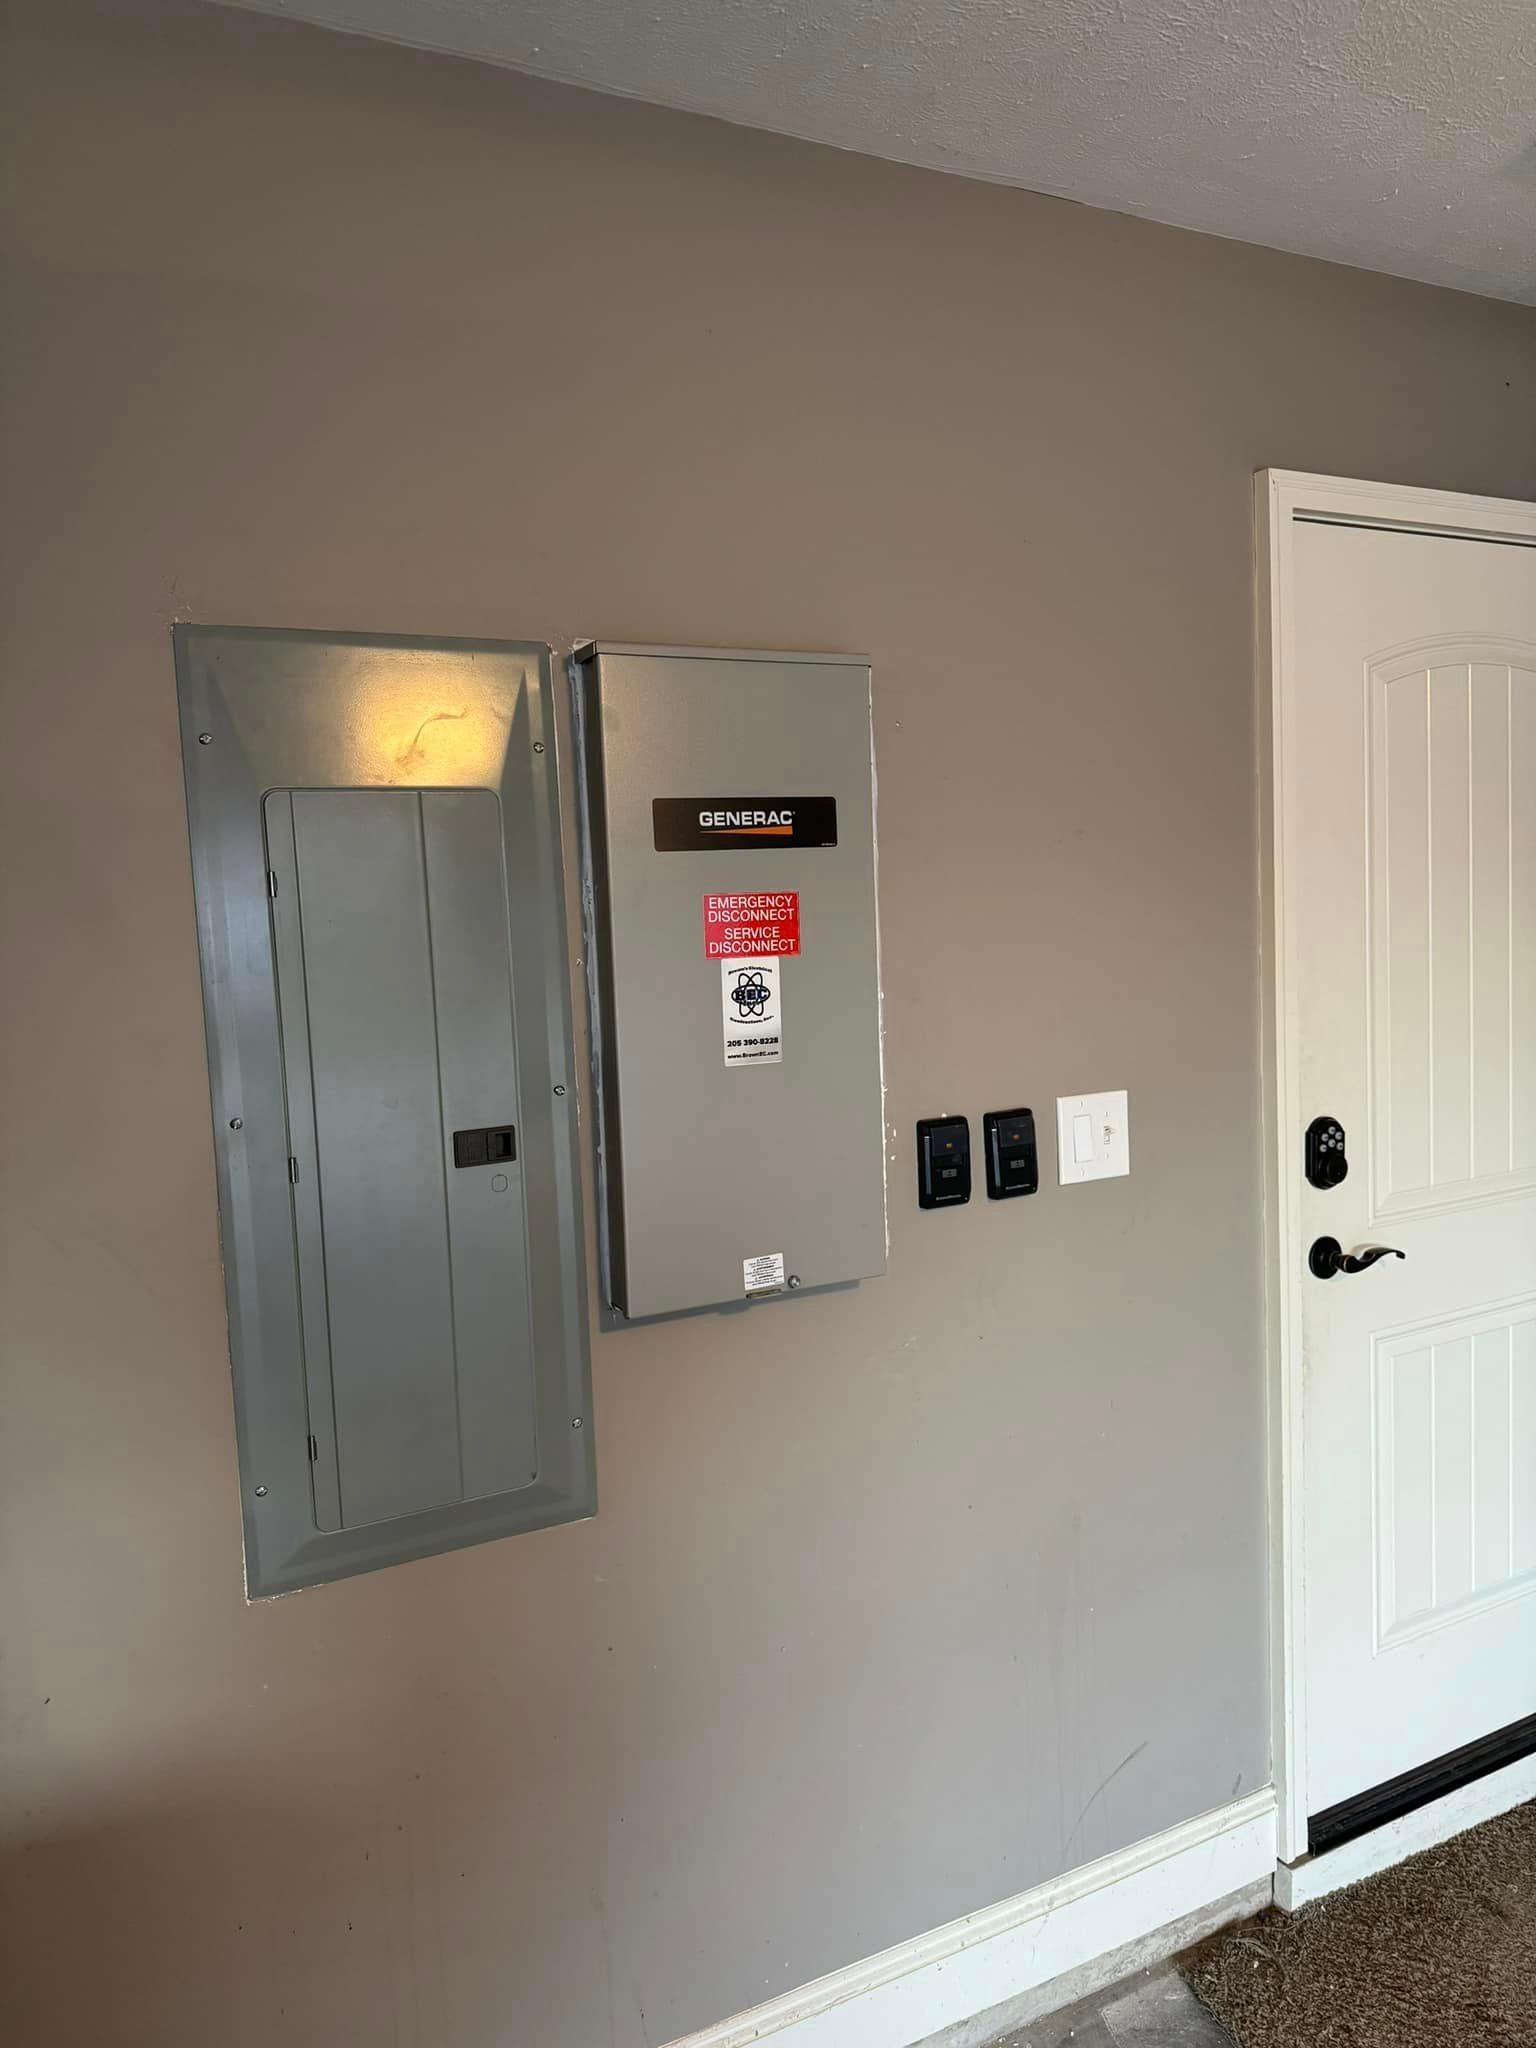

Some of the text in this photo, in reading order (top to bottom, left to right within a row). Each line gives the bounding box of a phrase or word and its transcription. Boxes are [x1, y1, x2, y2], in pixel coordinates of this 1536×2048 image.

[699, 811, 793, 827] GENERAC
[708, 895, 793, 909] EMERGENCY
[708, 908, 795, 923] DISCONNECT
[724, 926, 781, 940] SERVICE
[709, 938, 796, 954] DISCONNECT
